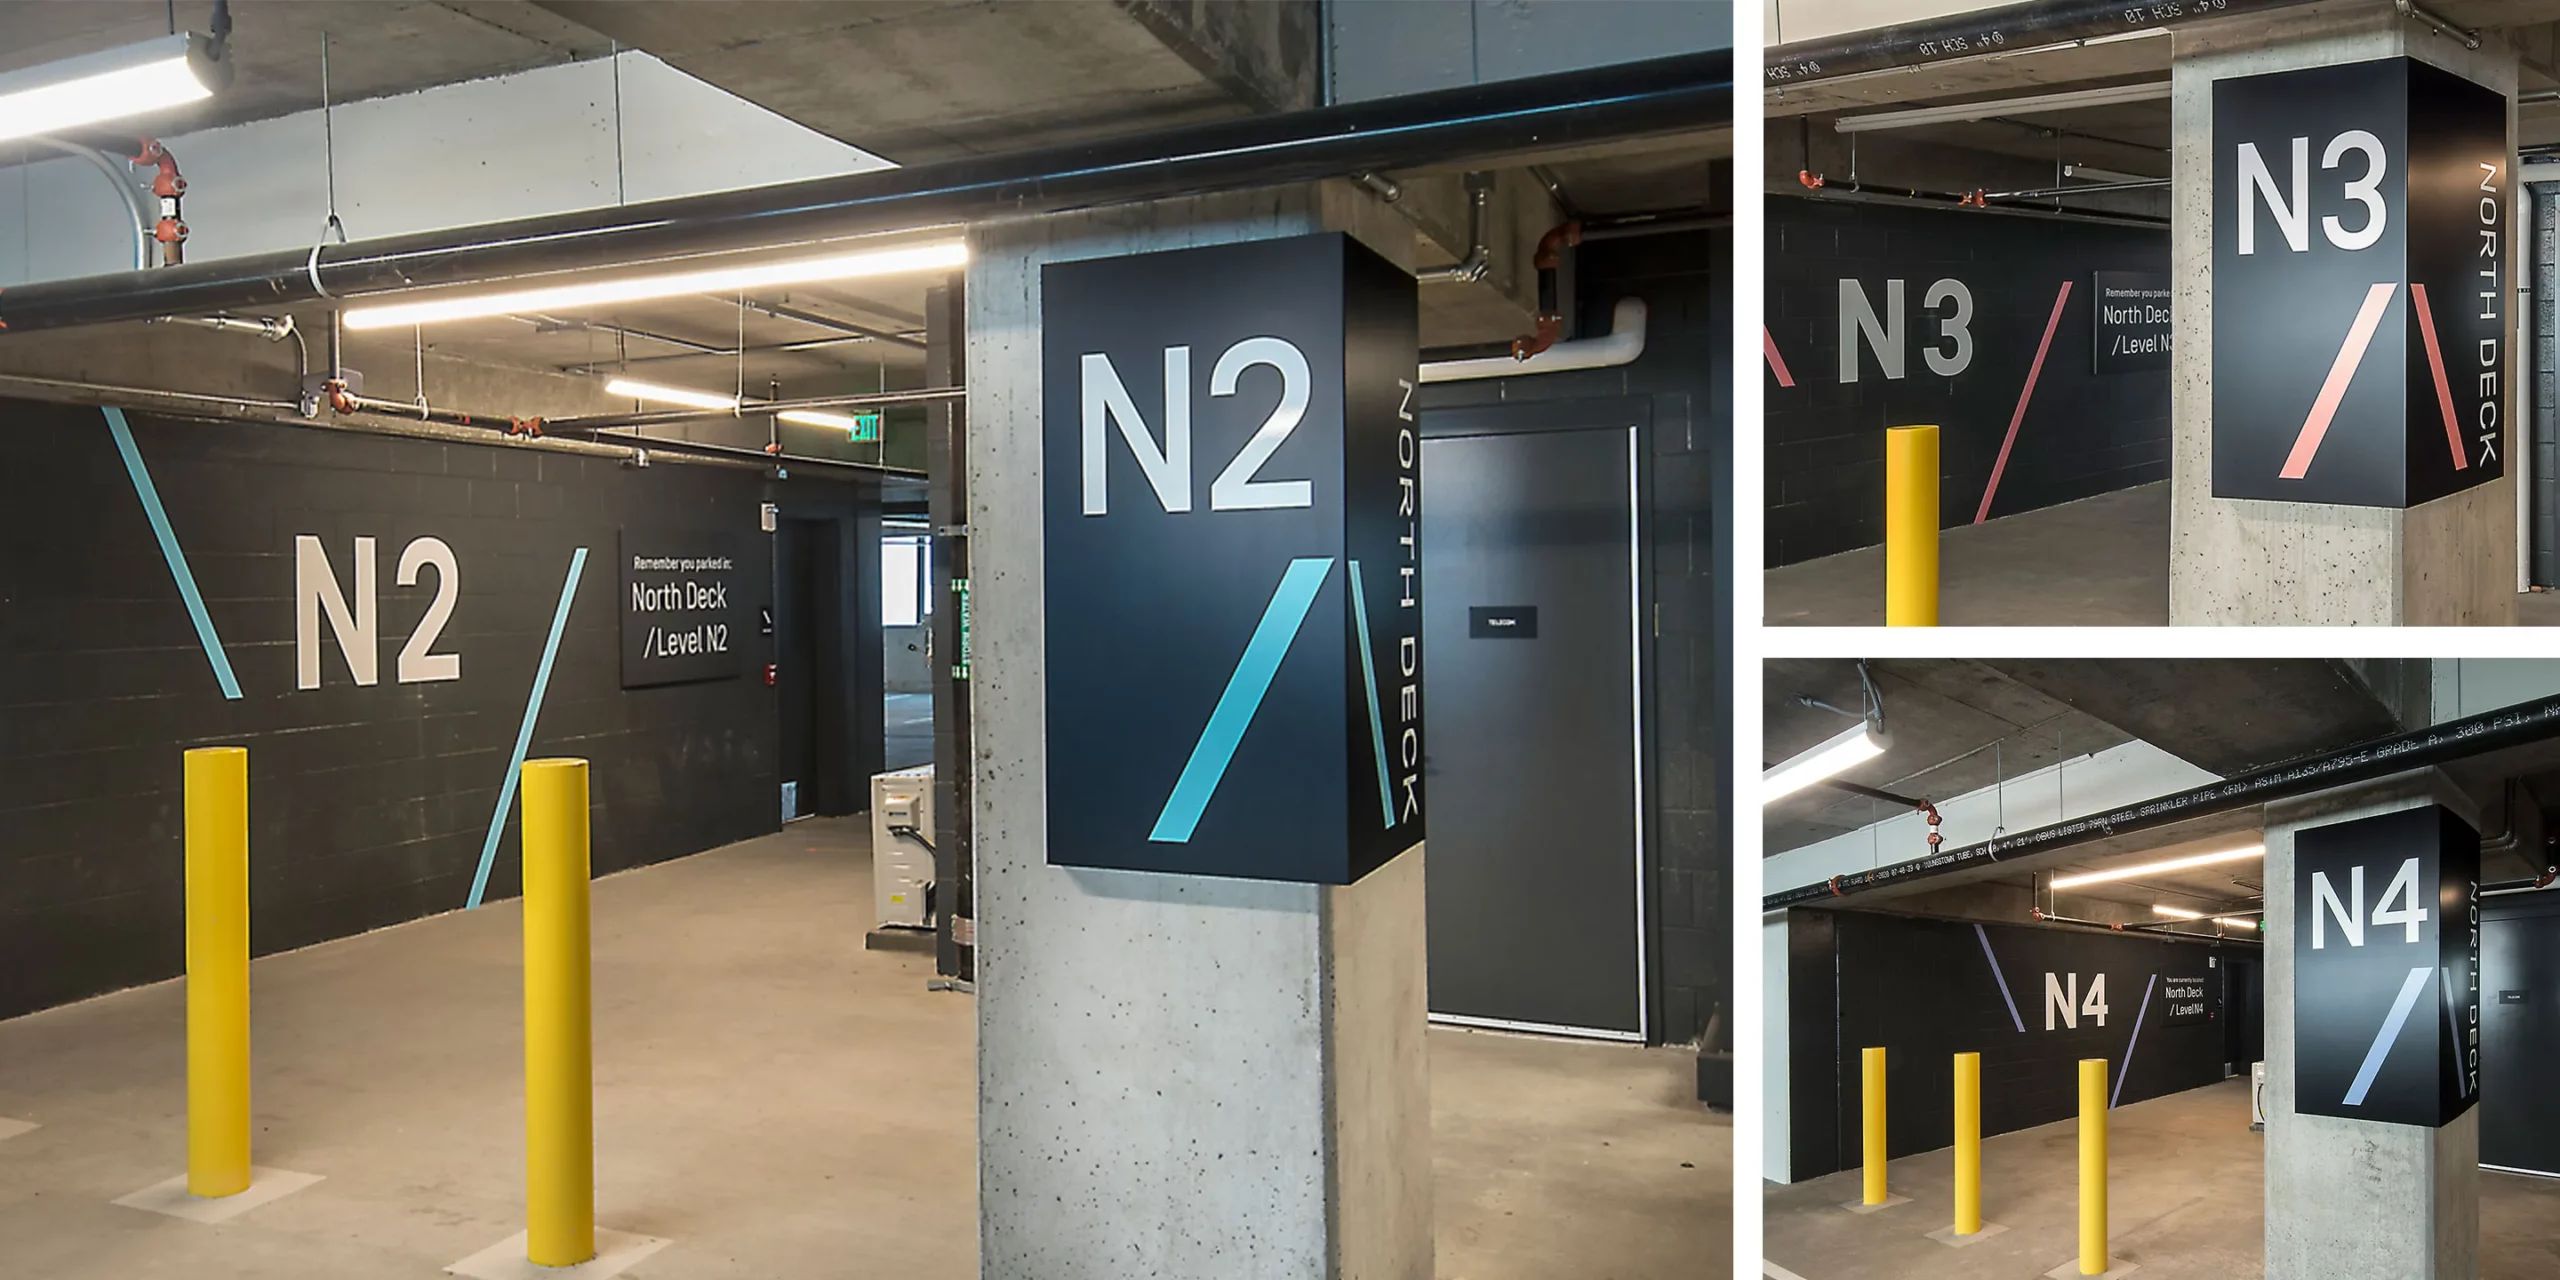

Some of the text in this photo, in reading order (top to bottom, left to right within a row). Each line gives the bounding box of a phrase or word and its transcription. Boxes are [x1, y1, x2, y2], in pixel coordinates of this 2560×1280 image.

[2125, 8, 2145, 24] 10
[2152, 2, 2183, 20] SCH
[1919, 41, 1938, 56] 10
[1941, 37, 1968, 52] SCH
[1765, 66, 1791, 80] SCH
[2237, 129, 2387, 255] N3
[2105, 288, 2172, 299] Remember you parke
[2104, 305, 2142, 324] North
[2479, 162, 2497, 467] NORTH DECK
[1838, 278, 1974, 384] N3
[851, 414, 879, 441] EXIT
[1082, 336, 1313, 516] N2
[633, 555, 678, 570] Remember
[680, 558, 694, 572] you
[696, 557, 722, 572] parked
[632, 581, 728, 611] North Deck
[1399, 379, 1418, 823] NORTH DECK
[295, 535, 461, 690] N2
[706, 624, 728, 653] N2
[1976, 847, 1987, 856] SCH
[2058, 822, 2086, 836] LISTED
[2110, 810, 2136, 824] STEEL
[2140, 797, 2188, 817] SPRINKLER
[2192, 790, 2216, 804] PIPE
[2376, 740, 2419, 758] GRADE
[2456, 722, 2484, 738] 300
[2310, 857, 2429, 950] N4
[2045, 972, 2109, 1031] N4
[2166, 986, 2204, 998] North Deck
[2469, 881, 2478, 1094] NORTH DECK
[2194, 1003, 2204, 1014] N4
